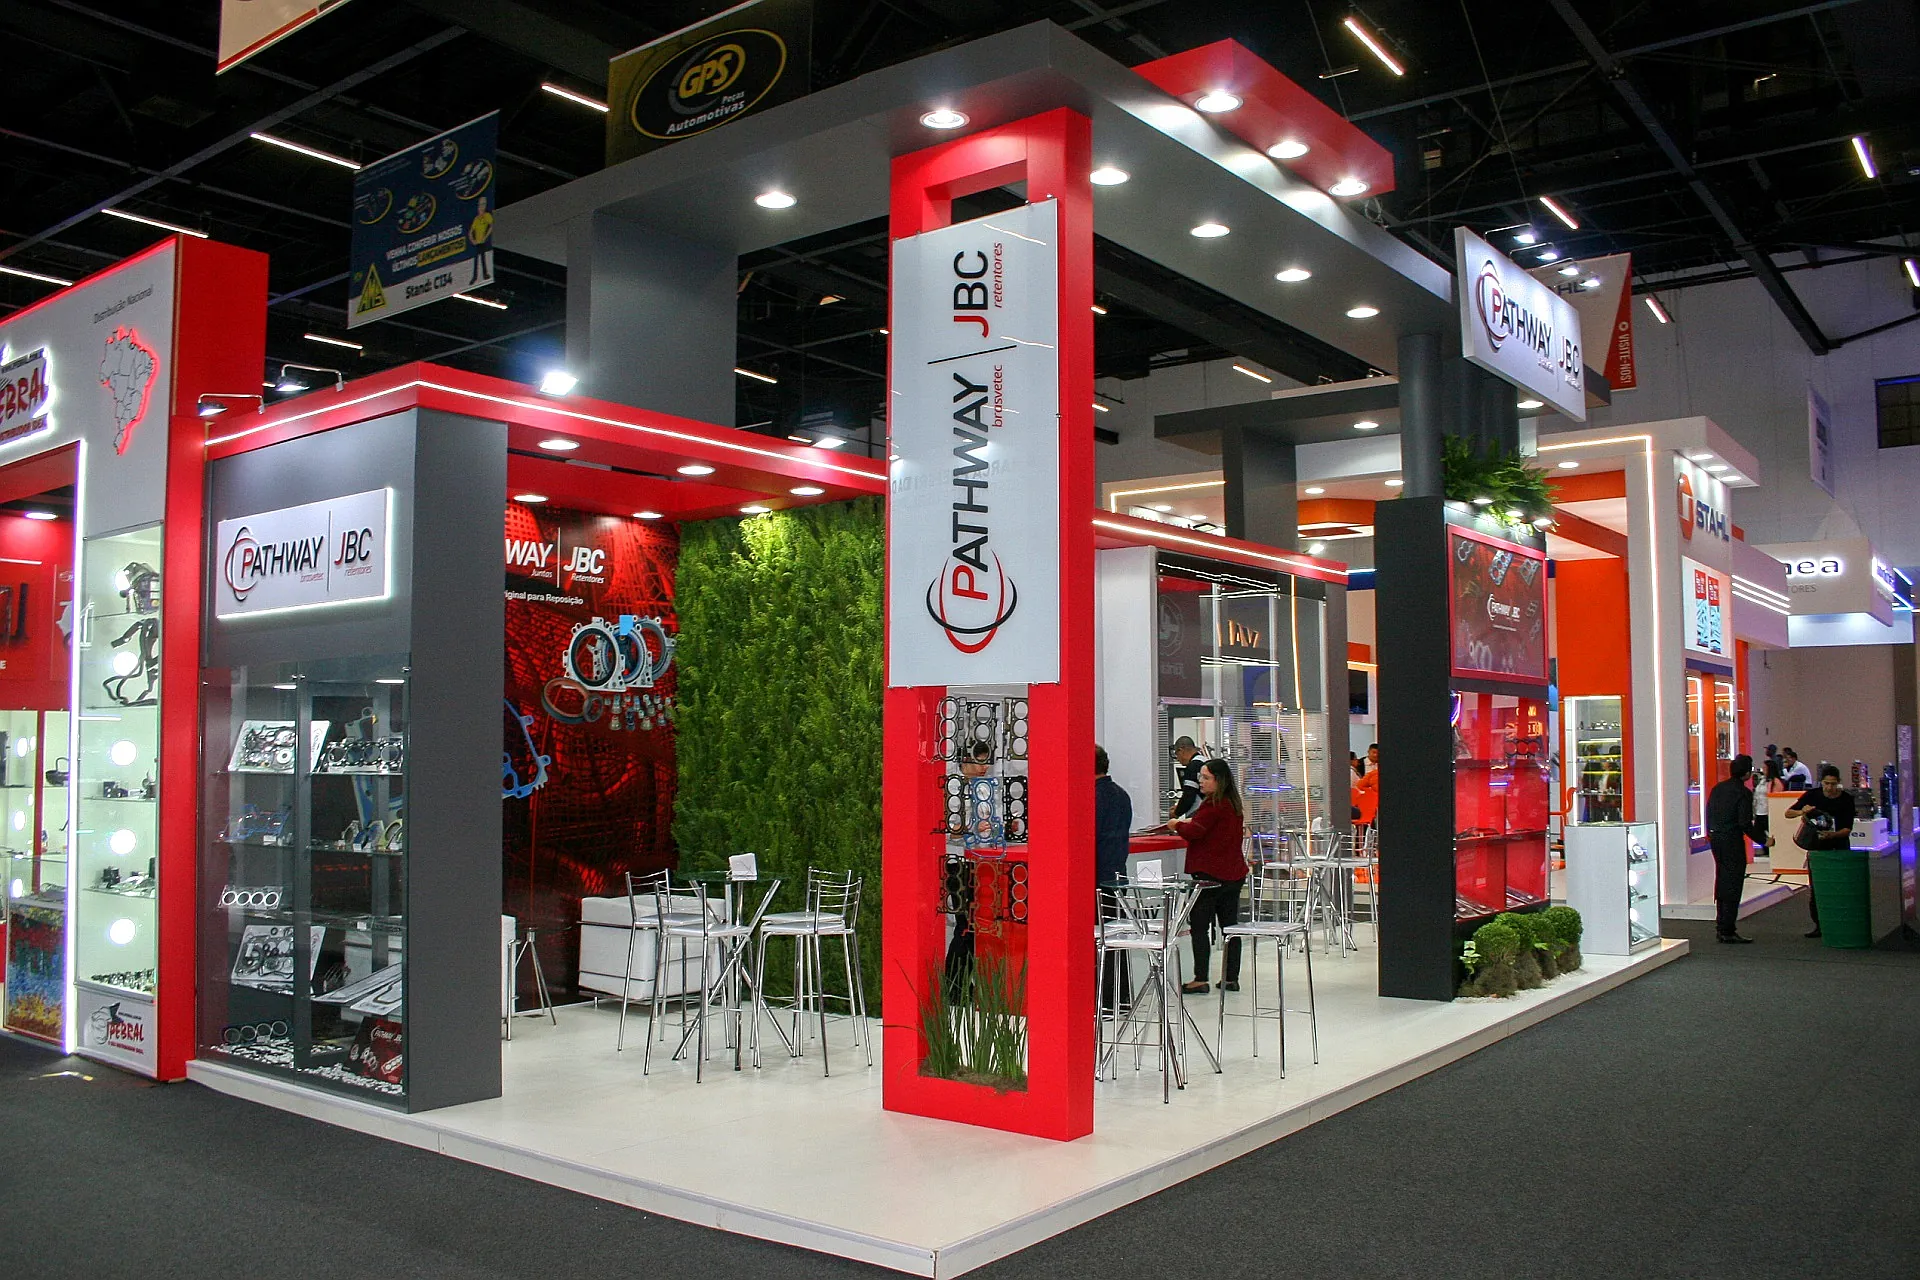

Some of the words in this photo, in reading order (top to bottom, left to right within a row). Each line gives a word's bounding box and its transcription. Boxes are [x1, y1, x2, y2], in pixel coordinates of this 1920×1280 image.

[679, 52, 733, 99] GPS
[721, 90, 745, 104] Peças
[666, 100, 746, 134] Automotivas
[127, 284, 154, 305] Nacional
[953, 250, 989, 338] JBC
[992, 242, 1003, 308] retentores
[1491, 287, 1552, 359] PATHWAY
[1558, 336, 1580, 378] JBC
[1618, 333, 1632, 384] VISITE-NOS!
[992, 365, 1003, 427] brasvetec
[952, 372, 989, 601] PATHWAY
[1696, 500, 1730, 542] STAHL
[241, 536, 324, 579] PATHWAY
[334, 528, 373, 565] JBC
[563, 546, 605, 575] JBC
[531, 569, 553, 578] Juntas
[571, 573, 605, 584] Retentores
[527, 593, 544, 602] para
[546, 593, 584, 605] Reposição
[109, 1022, 144, 1041] PEBRAL
